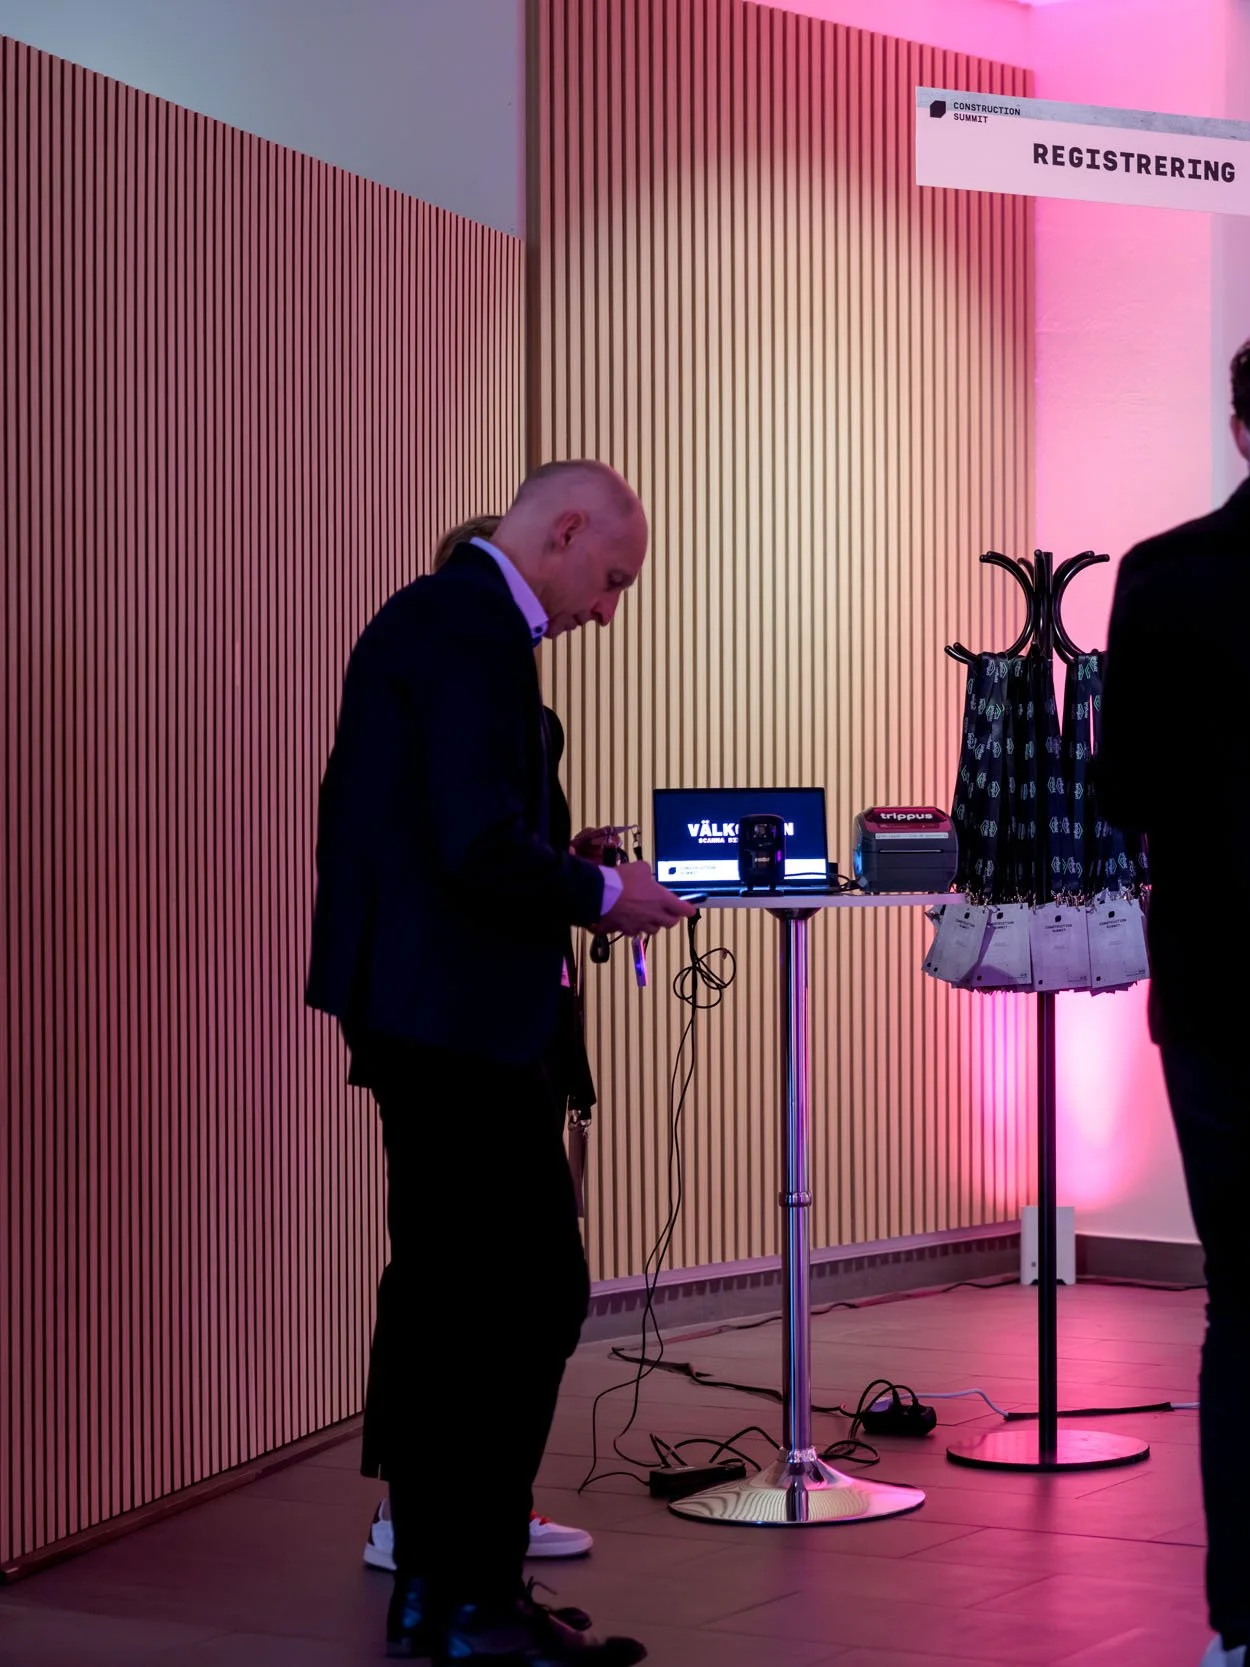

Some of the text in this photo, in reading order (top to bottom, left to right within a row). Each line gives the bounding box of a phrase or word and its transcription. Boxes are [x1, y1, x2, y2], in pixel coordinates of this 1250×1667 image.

[953, 101, 1021, 116] CONSTRUCTION
[953, 113, 988, 124] SUMMIT
[1033, 143, 1236, 183] REGISTRERING
[880, 812, 933, 821] trippus
[688, 820, 794, 837] VÄLKN
